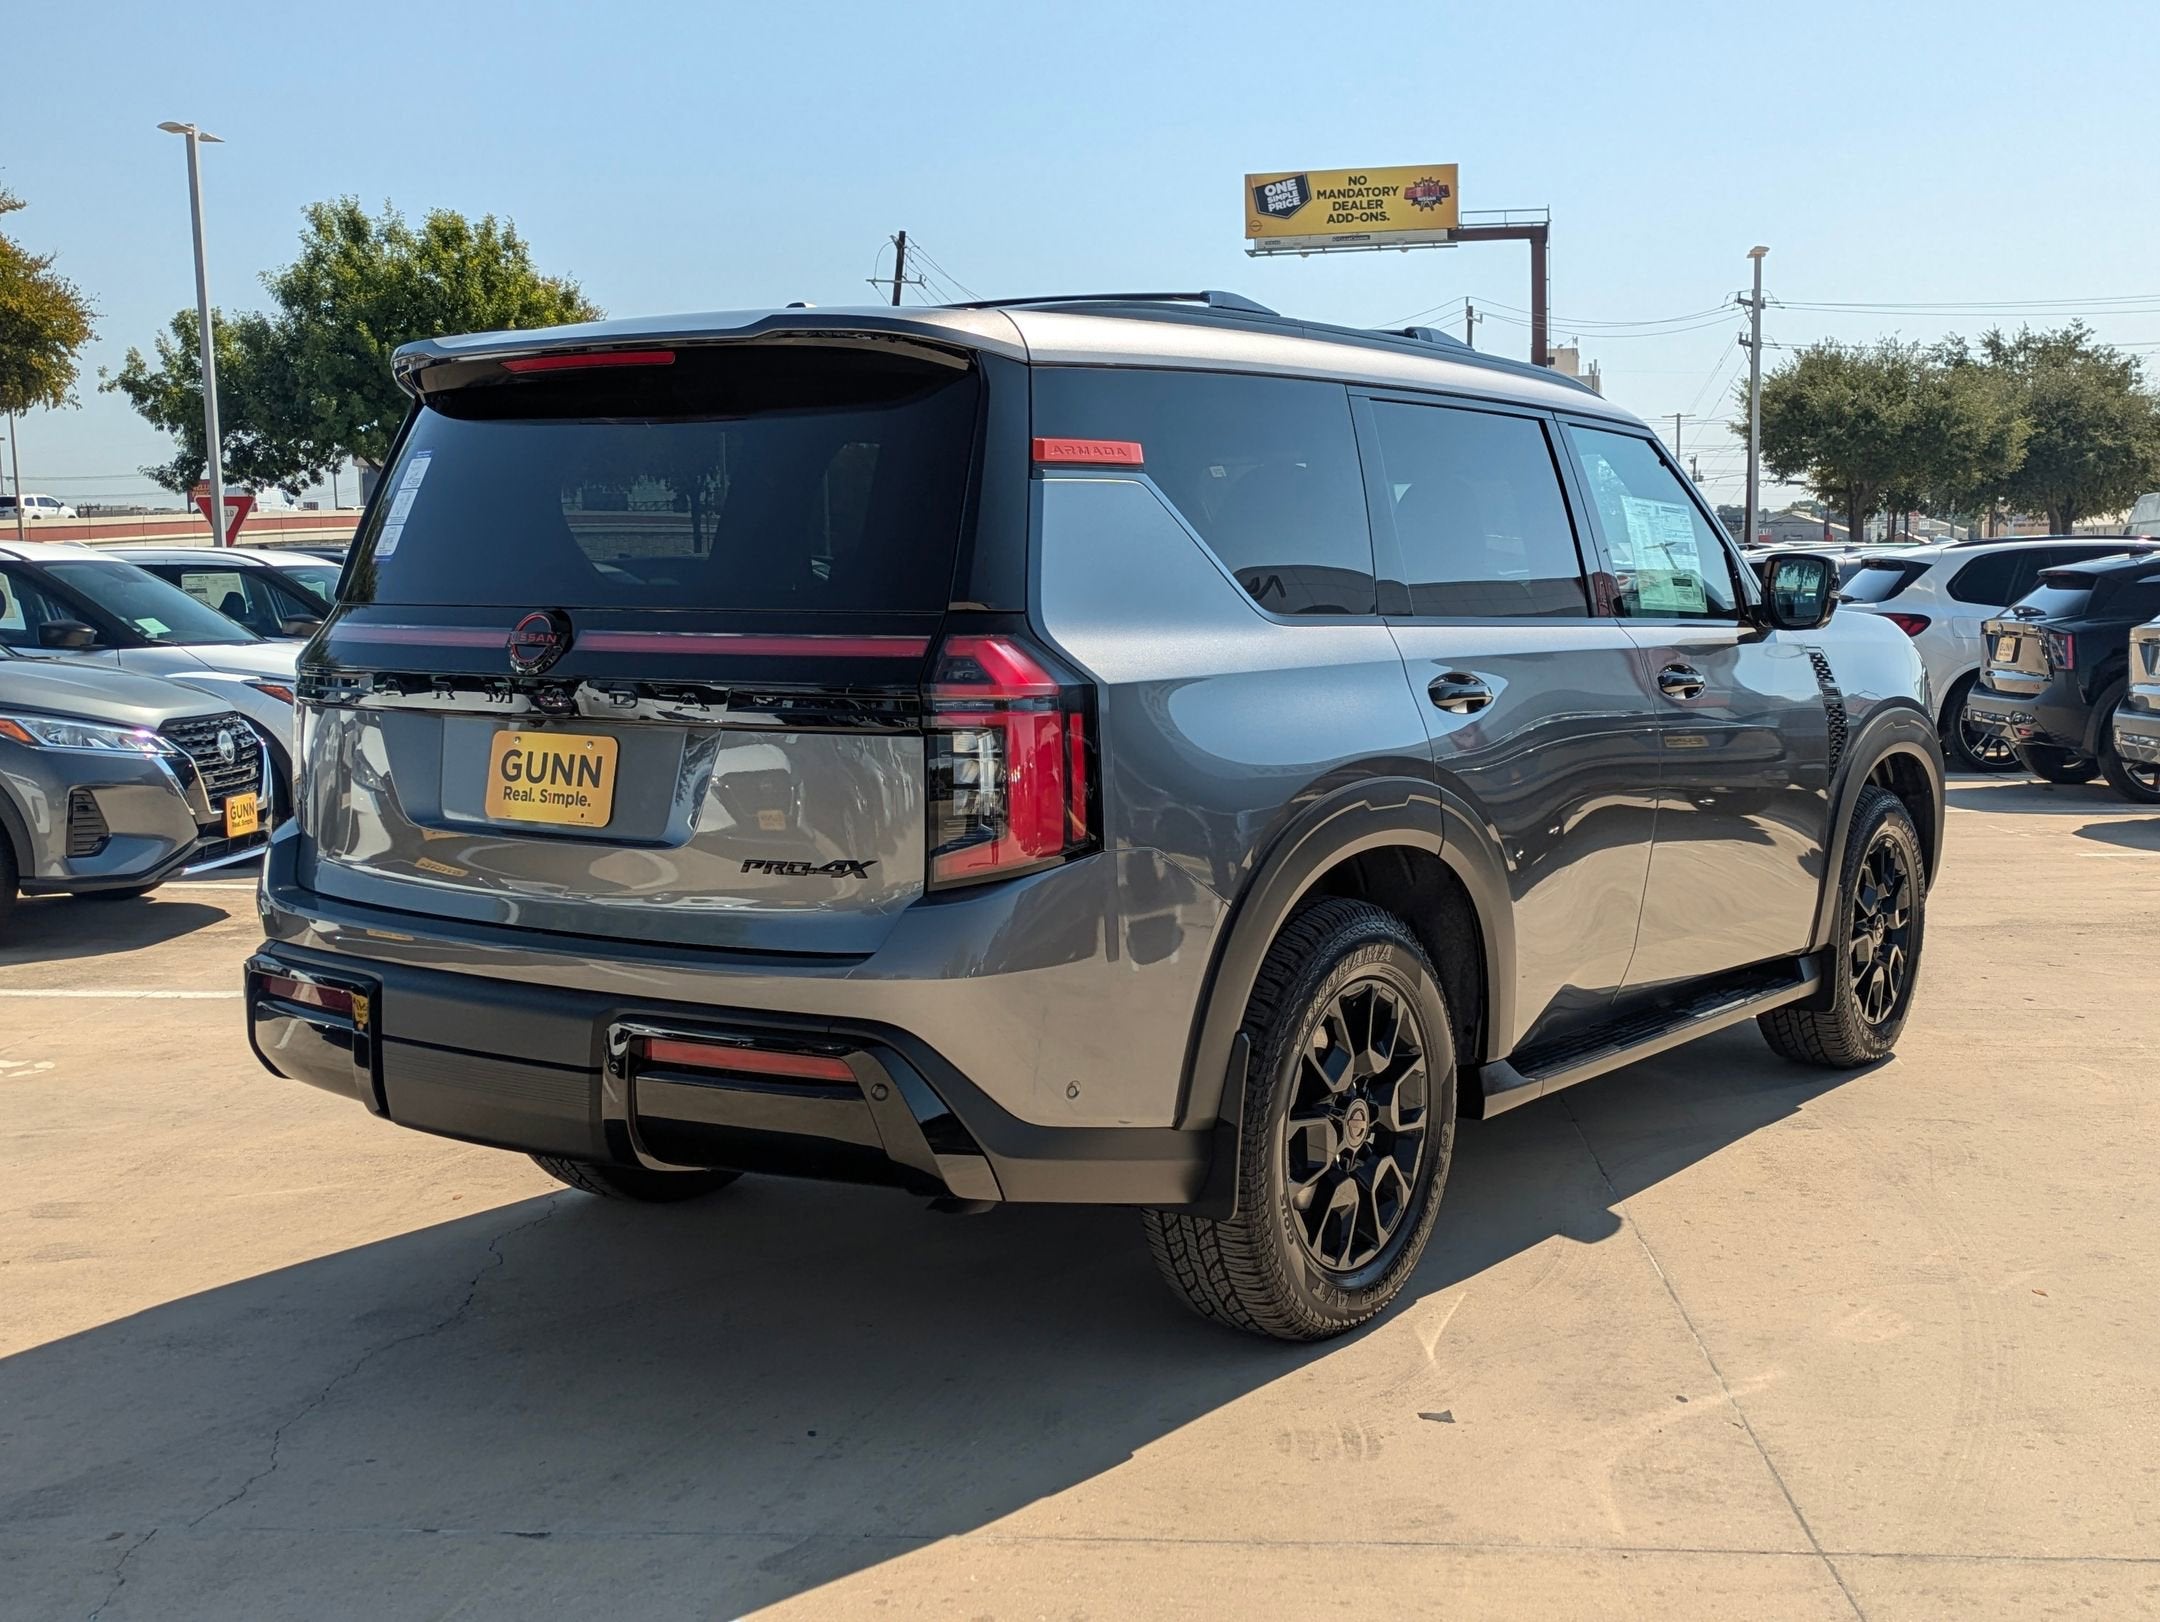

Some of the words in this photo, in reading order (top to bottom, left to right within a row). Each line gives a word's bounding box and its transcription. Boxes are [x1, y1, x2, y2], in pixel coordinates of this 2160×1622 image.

[1264, 178, 1297, 197] ONE
[1348, 175, 1367, 186] NO
[1267, 190, 1299, 204] SIMPLE
[1316, 186, 1400, 199] MANDATORY
[1268, 197, 1301, 212] PRICE
[1332, 200, 1384, 211] DEALER
[1326, 211, 1390, 224] ADD-ONS.
[1052, 444, 1127, 457] ARMADA
[501, 749, 603, 788] GUNN
[503, 786, 535, 802] Real.
[230, 802, 254, 820] GUNN
[740, 859, 878, 879] PRO-4X
[1292, 944, 1394, 1056] YOKOHAMA
